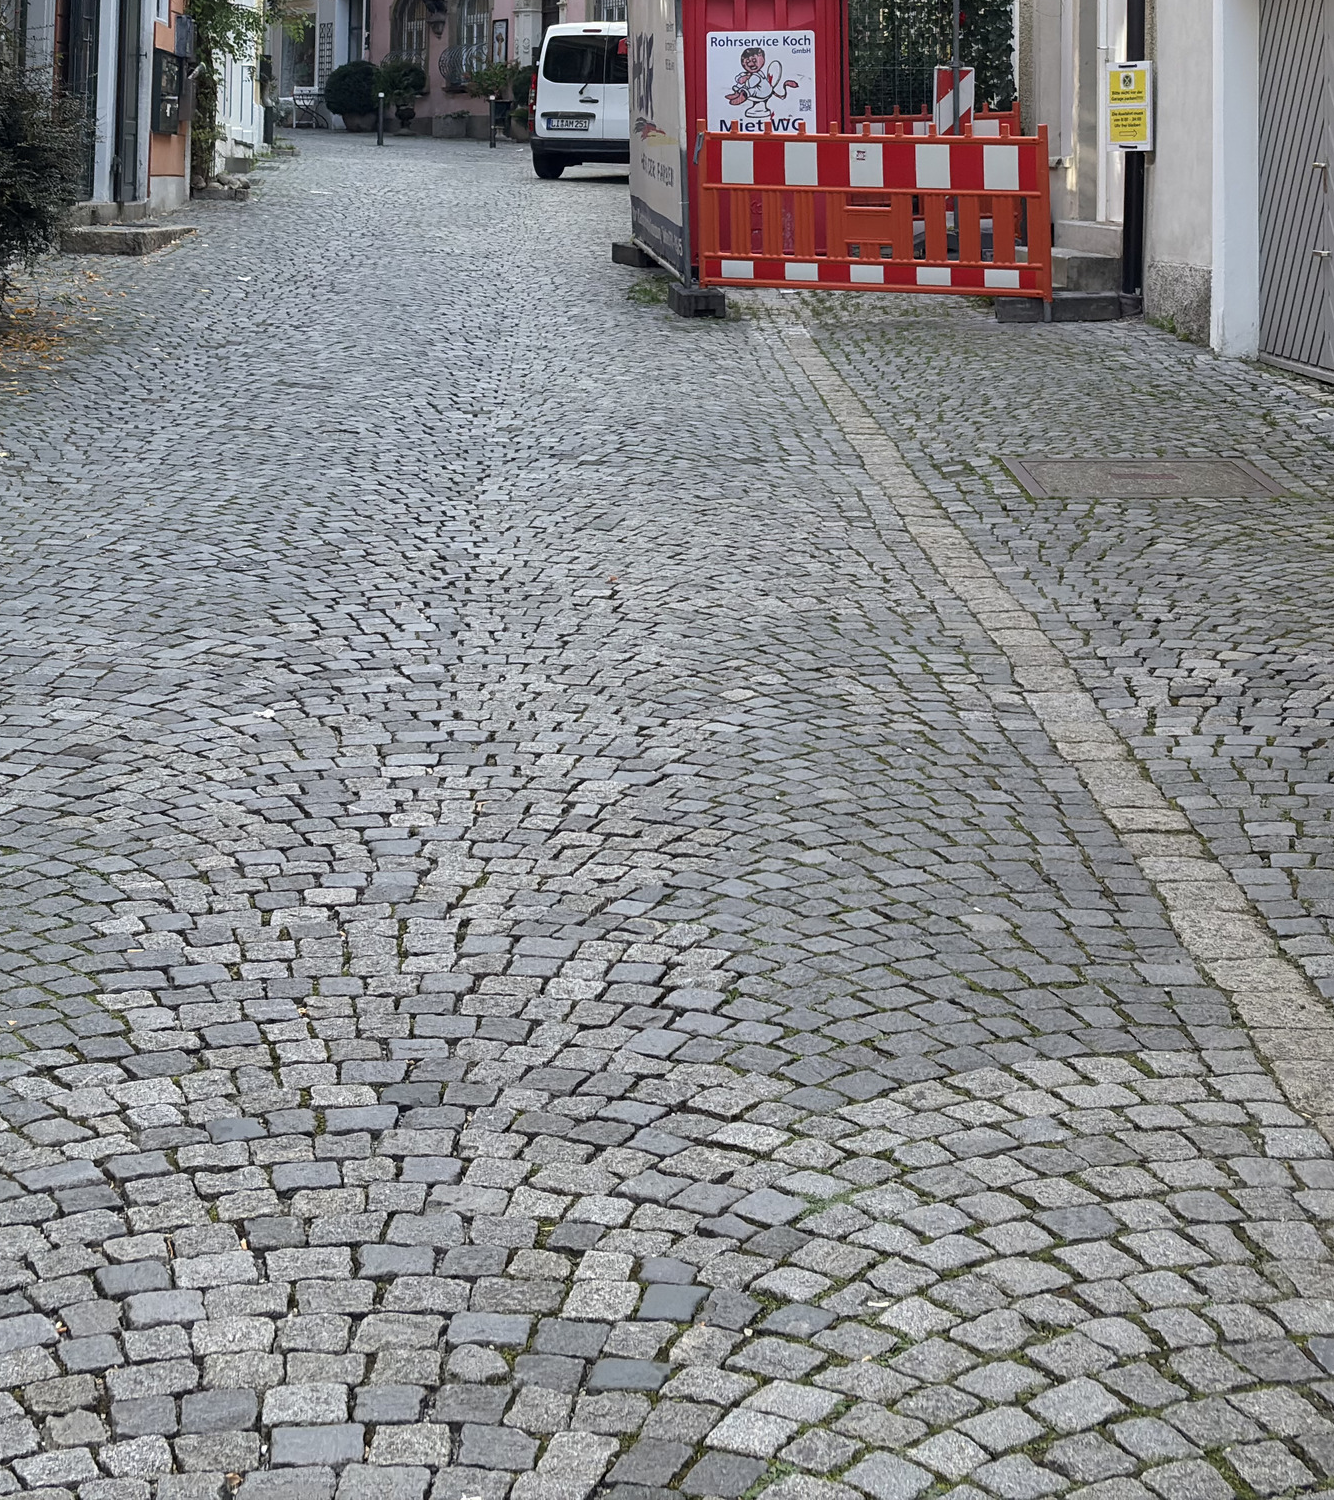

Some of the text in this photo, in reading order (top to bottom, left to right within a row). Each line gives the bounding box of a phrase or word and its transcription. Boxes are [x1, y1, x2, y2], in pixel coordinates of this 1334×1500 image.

[710, 35, 811, 48] Rohrservice Koch
[575, 120, 587, 128] 251
[720, 118, 764, 132] Miet
